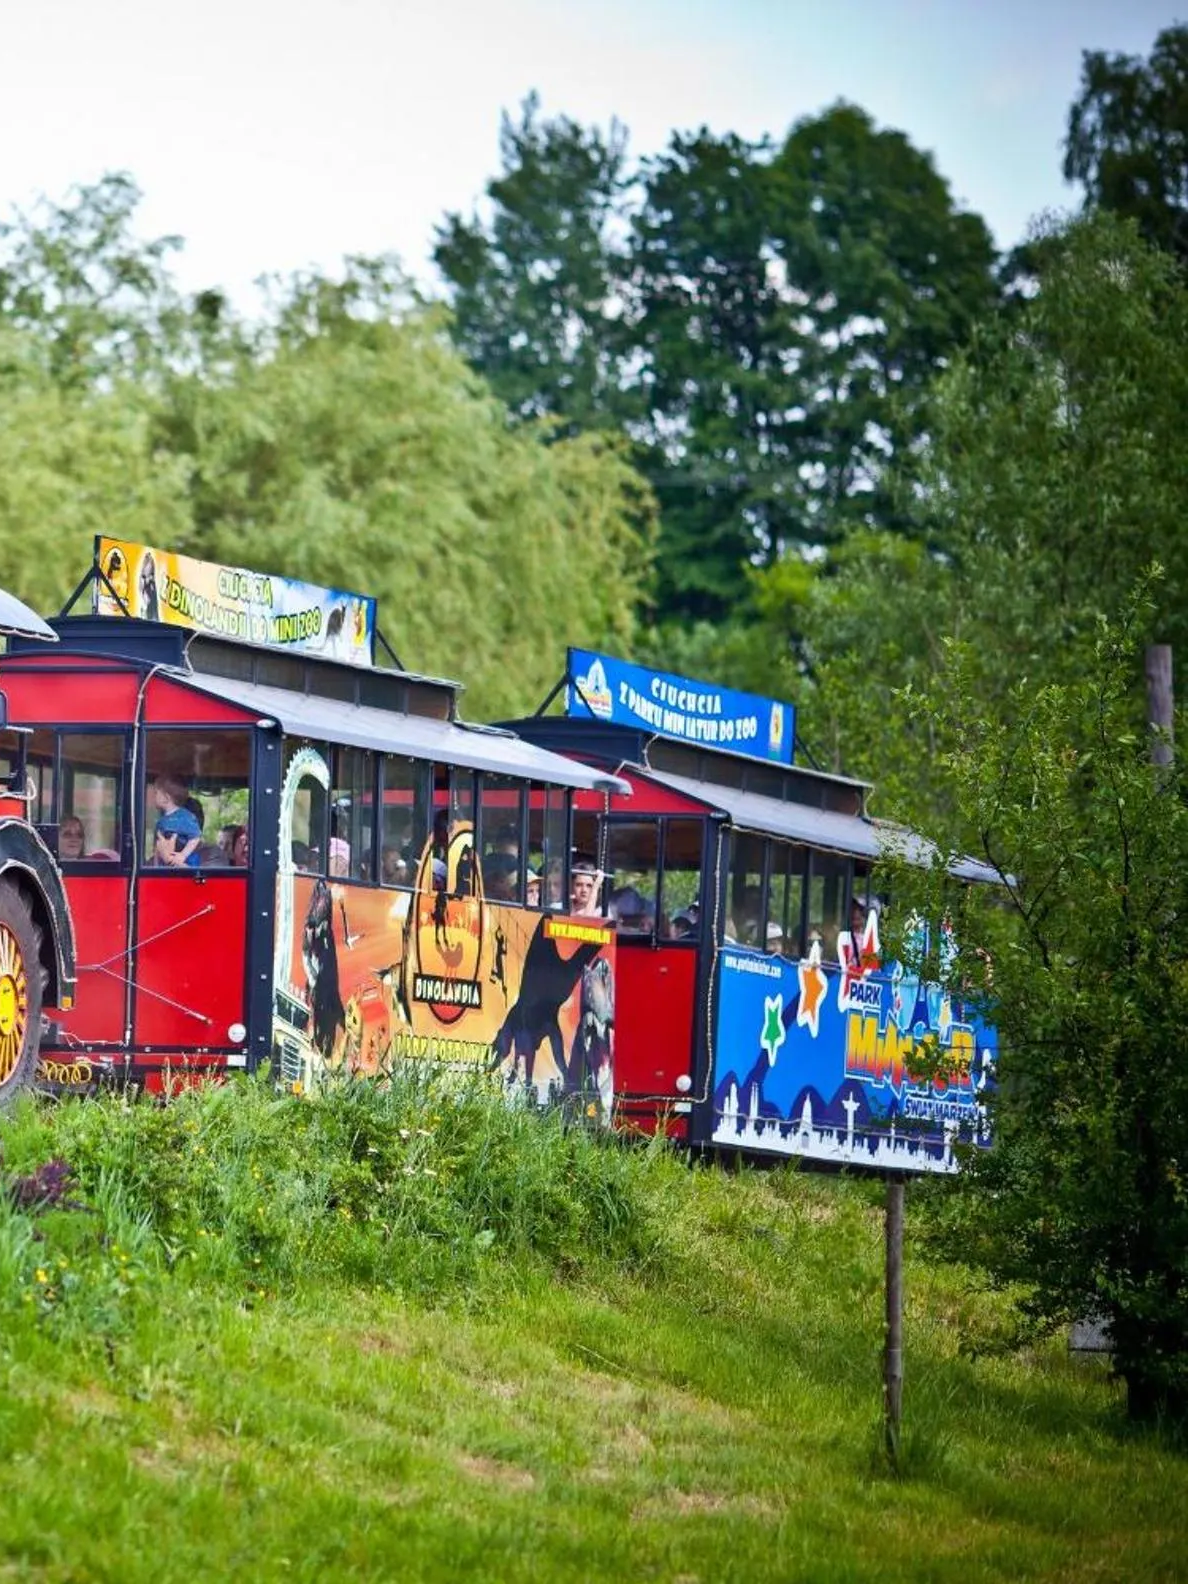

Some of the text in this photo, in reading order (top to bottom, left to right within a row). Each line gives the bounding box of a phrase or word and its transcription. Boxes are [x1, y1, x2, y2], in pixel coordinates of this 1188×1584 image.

[269, 613, 298, 644] MINI
[299, 606, 323, 640] ZOO
[619, 680, 629, 705] Z
[628, 687, 663, 728] PARKU
[719, 719, 734, 742] DO
[735, 715, 758, 740] ZOO
[651, 677, 722, 714] CIUCHCIA
[415, 978, 481, 1005] DINOLANDIA
[849, 982, 881, 1006] PARK
